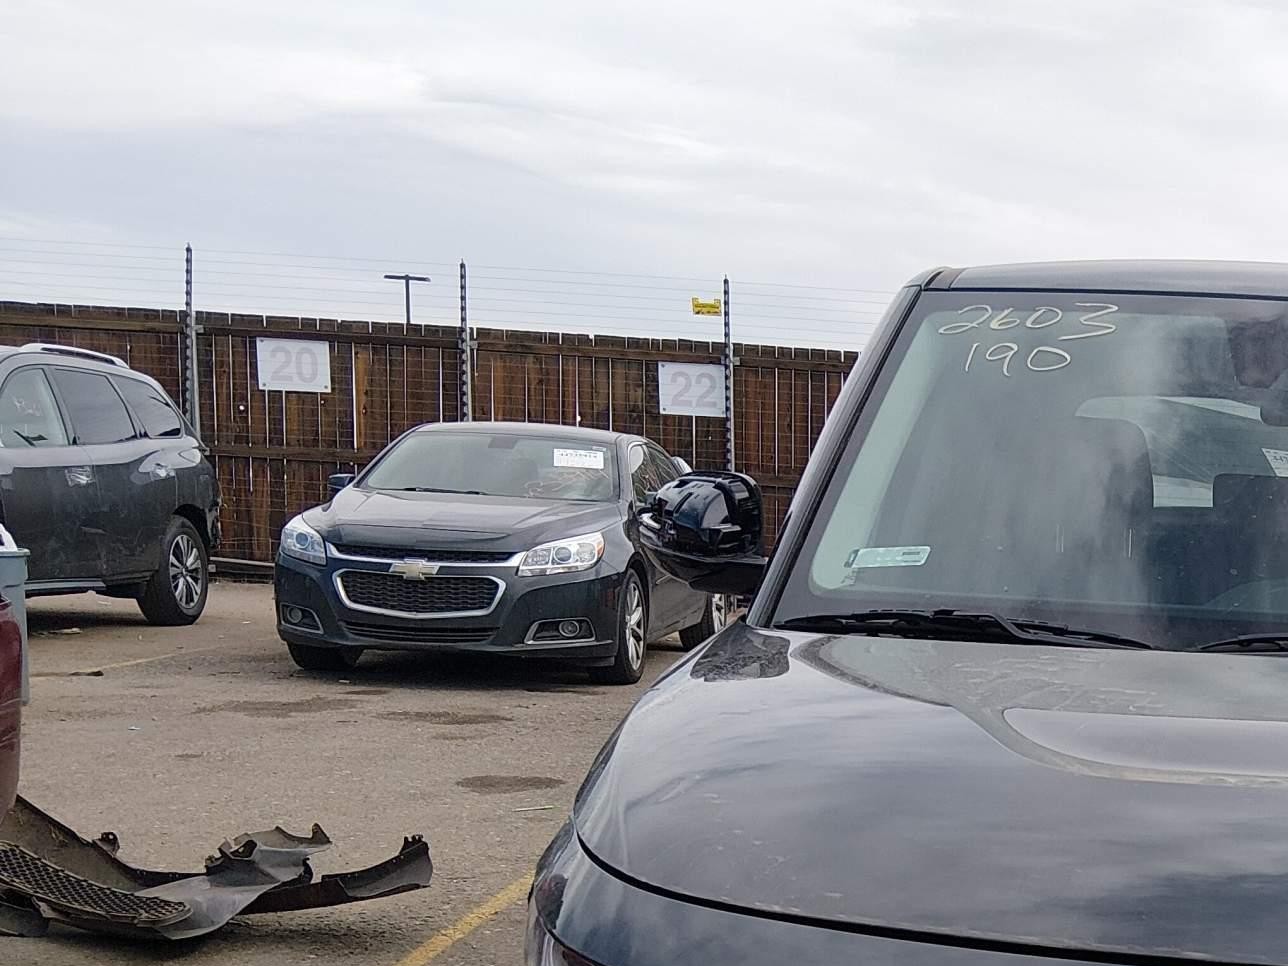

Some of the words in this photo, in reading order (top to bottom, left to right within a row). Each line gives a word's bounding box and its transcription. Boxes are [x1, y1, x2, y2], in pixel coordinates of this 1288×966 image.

[938, 302, 1118, 341] 2603
[270, 345, 319, 383] 20
[965, 342, 1071, 377] 190
[670, 371, 717, 408] 22
